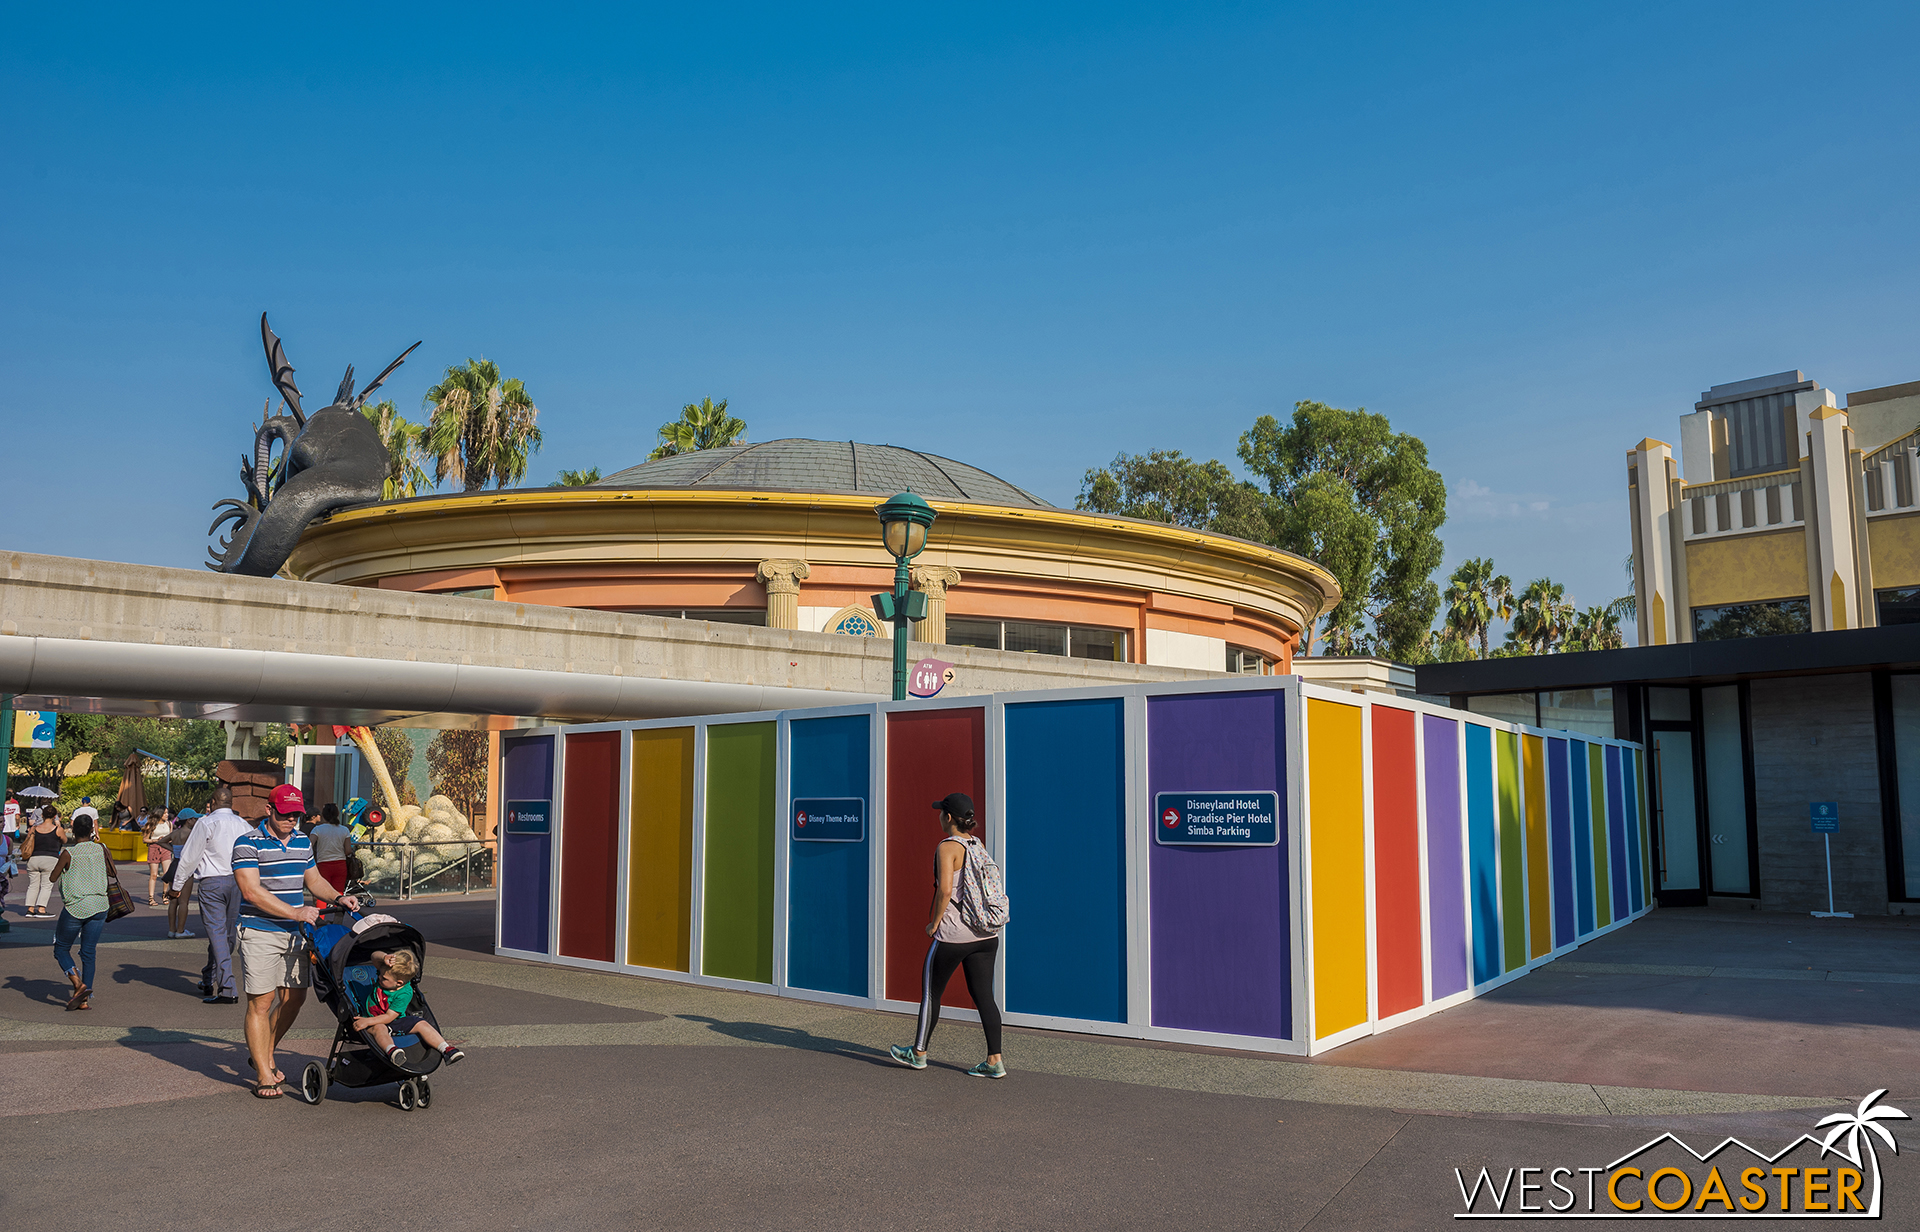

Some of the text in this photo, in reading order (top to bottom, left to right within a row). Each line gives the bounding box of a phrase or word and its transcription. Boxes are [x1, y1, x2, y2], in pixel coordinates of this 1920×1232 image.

[1187, 799, 1260, 811] Disneyland Hotel
[517, 812, 544, 821] Restrooms
[808, 814, 859, 824] Disney Theme Parks
[1187, 813, 1272, 823] Paradise Pier Hotel
[1187, 825, 1251, 838] Simba Parking
